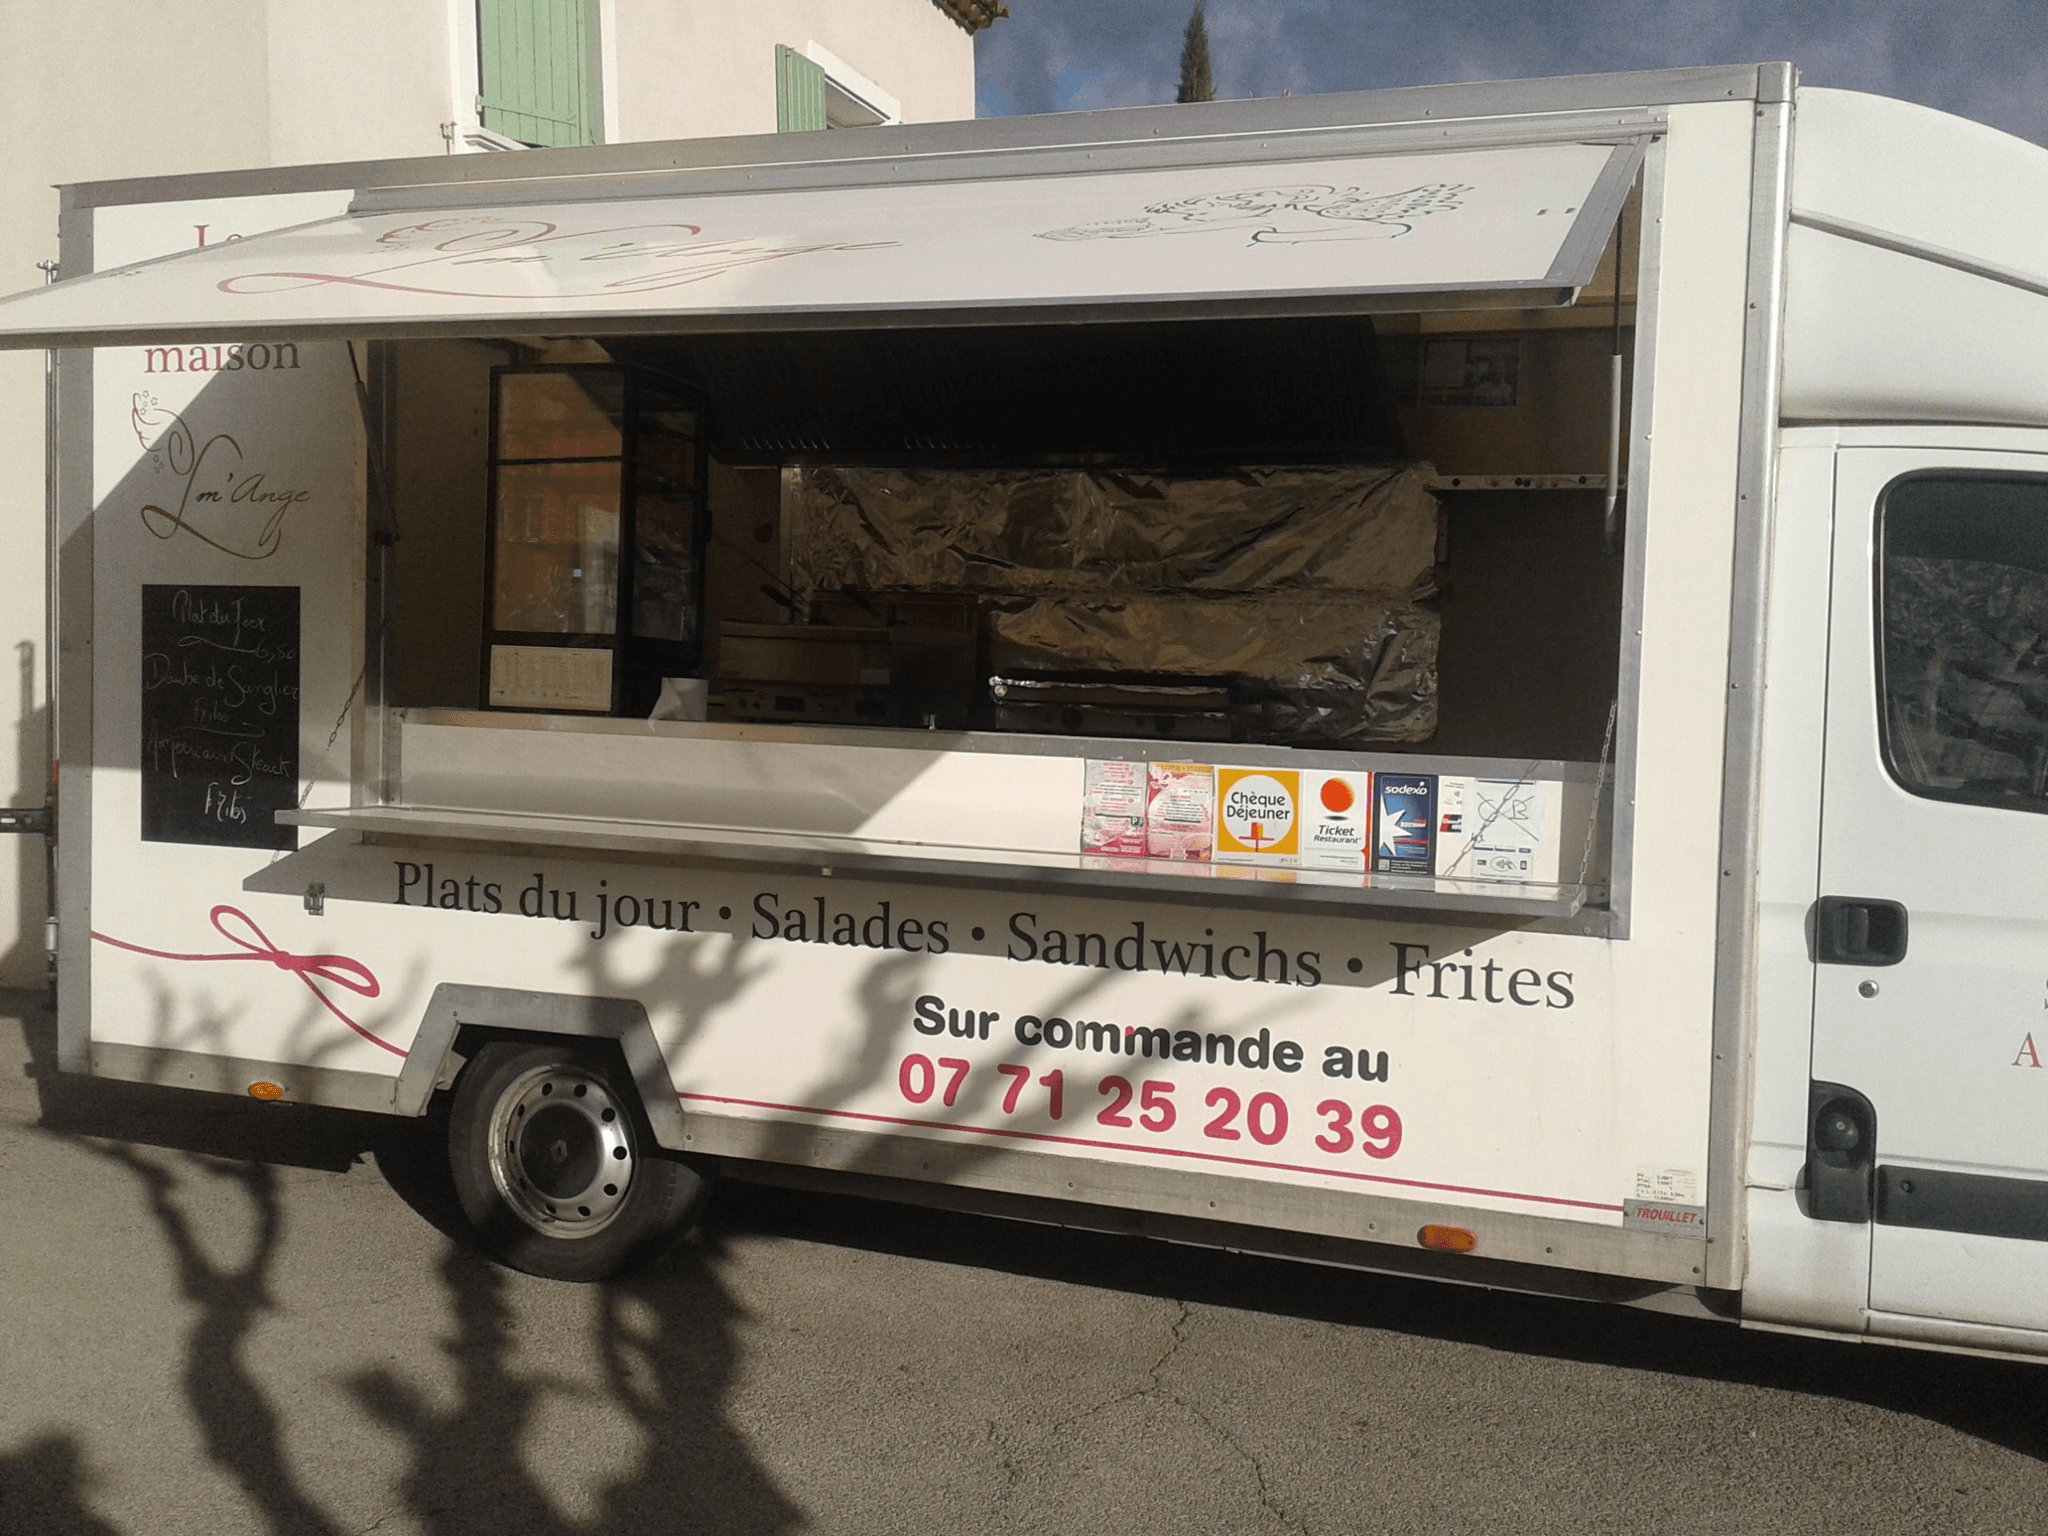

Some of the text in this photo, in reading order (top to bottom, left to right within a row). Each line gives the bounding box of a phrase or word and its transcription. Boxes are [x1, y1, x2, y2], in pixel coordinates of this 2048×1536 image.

[144, 342, 301, 373] maison
[172, 589, 209, 632] Plat
[209, 600, 231, 626] du
[1231, 791, 1286, 808] Chèque
[1384, 781, 1428, 795] sodexo
[1226, 805, 1290, 821] Déjeuner
[1318, 825, 1355, 836] Ticket
[393, 860, 1575, 1010] Plats du jour Salades Sandwichs Frites
[913, 995, 1389, 1083] Sur commande au
[899, 1053, 1403, 1160] 07 71 25 20 39
[1637, 1207, 1698, 1223] TROUILLET
